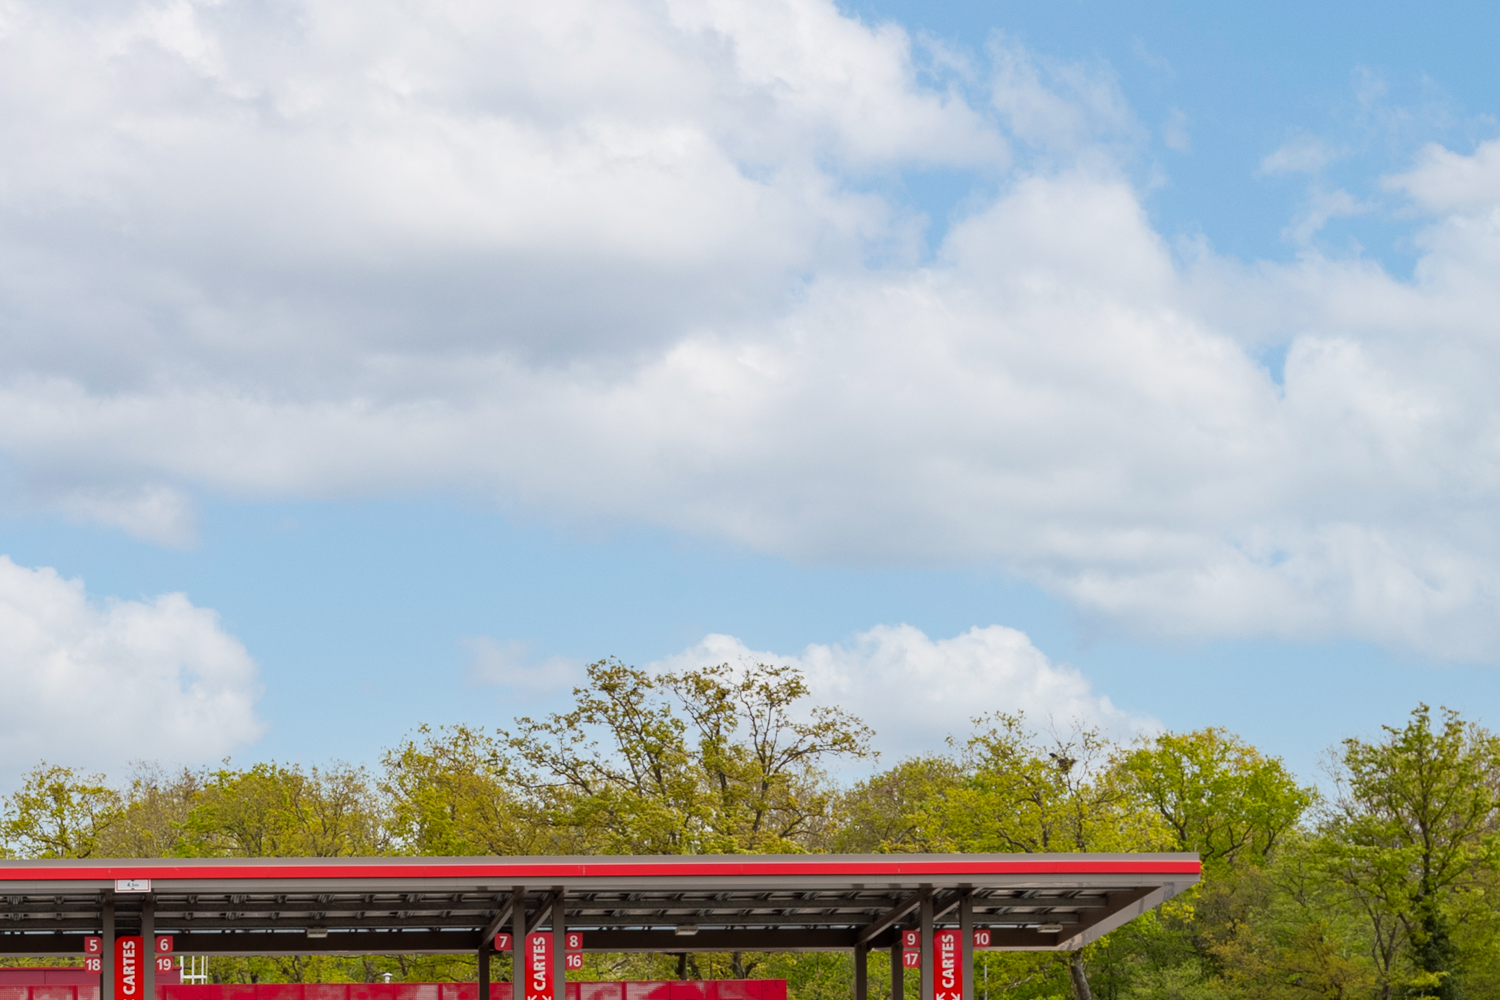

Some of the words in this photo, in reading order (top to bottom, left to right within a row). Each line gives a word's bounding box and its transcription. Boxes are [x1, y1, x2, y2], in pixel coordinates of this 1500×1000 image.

[89, 939, 98, 951] 5
[160, 938, 168, 950] 6
[500, 936, 508, 948] 7
[570, 935, 578, 948] 8
[907, 933, 916, 946] 9
[974, 932, 989, 945] 10
[86, 958, 100, 971] 18
[156, 958, 172, 970] 19
[532, 936, 546, 991] CARTES
[566, 954, 581, 967] 16
[904, 953, 918, 966] 17
[942, 934, 955, 988] CARTES
[122, 940, 136, 995] CARTES
